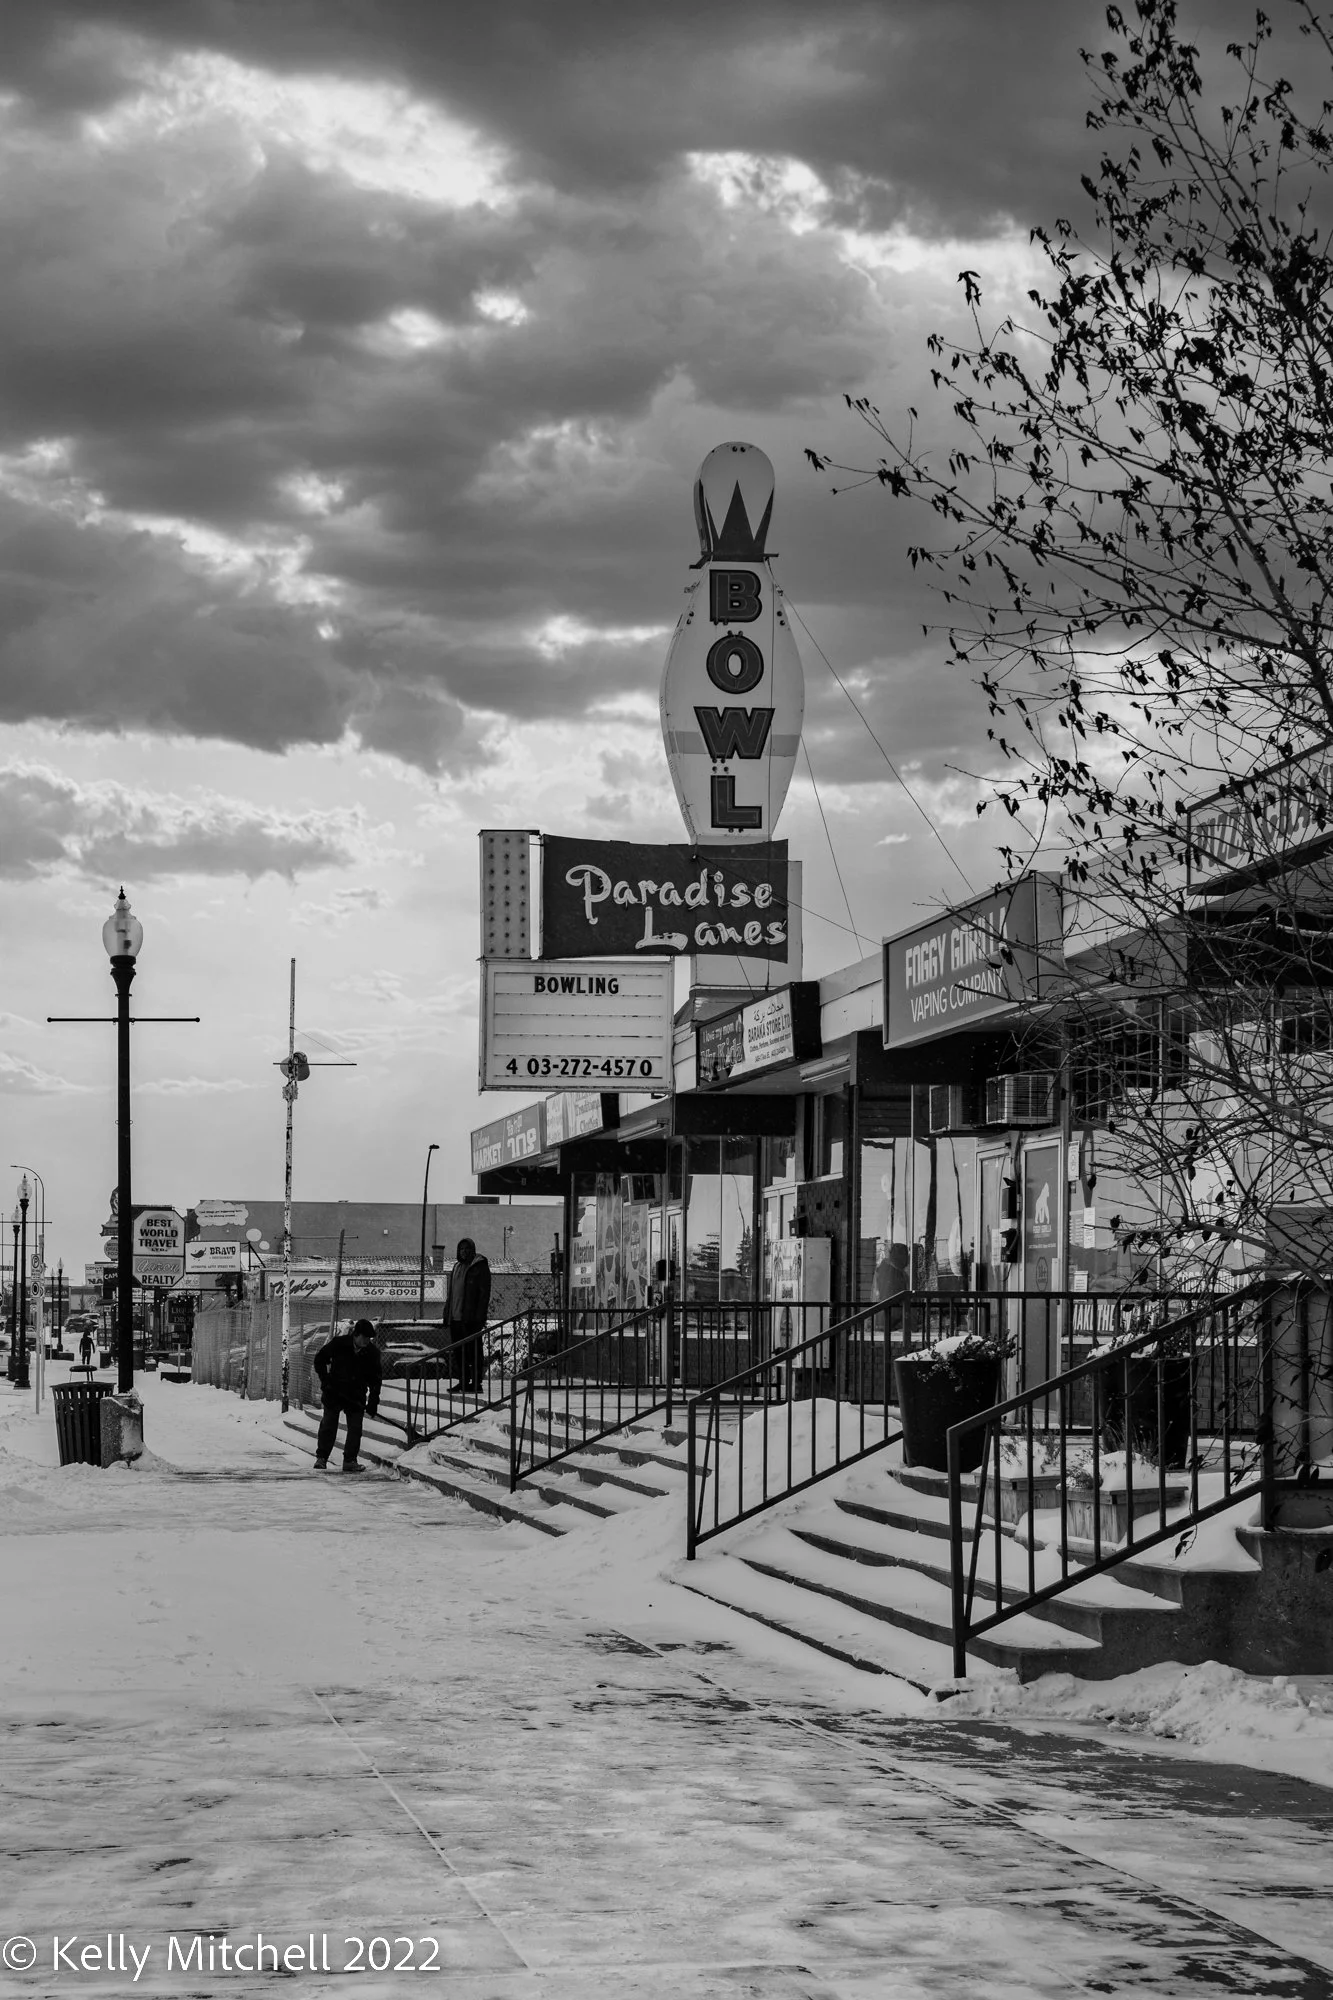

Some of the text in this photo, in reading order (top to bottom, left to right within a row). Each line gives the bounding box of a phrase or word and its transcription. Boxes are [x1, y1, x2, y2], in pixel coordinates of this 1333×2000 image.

[693, 569, 776, 829] BOWL
[565, 864, 773, 925] Paradise
[635, 906, 787, 951] Lanes
[905, 906, 1009, 990] FOGGY GORILLA
[534, 976, 620, 995] BOWLING
[910, 966, 1004, 1023] VAPING COMPANY
[748, 1022, 766, 1043] BARAKA
[766, 1016, 781, 1036] STORE
[473, 1141, 502, 1171] MARKET
[139, 1229, 179, 1238] WORLD
[146, 1219, 173, 1227] BEST
[138, 1238, 179, 1248] TRAVEL
[209, 1246, 236, 1256] BRAVO
[141, 1275, 176, 1285] REALTY
[363, 1288, 418, 1296] 569-8098
